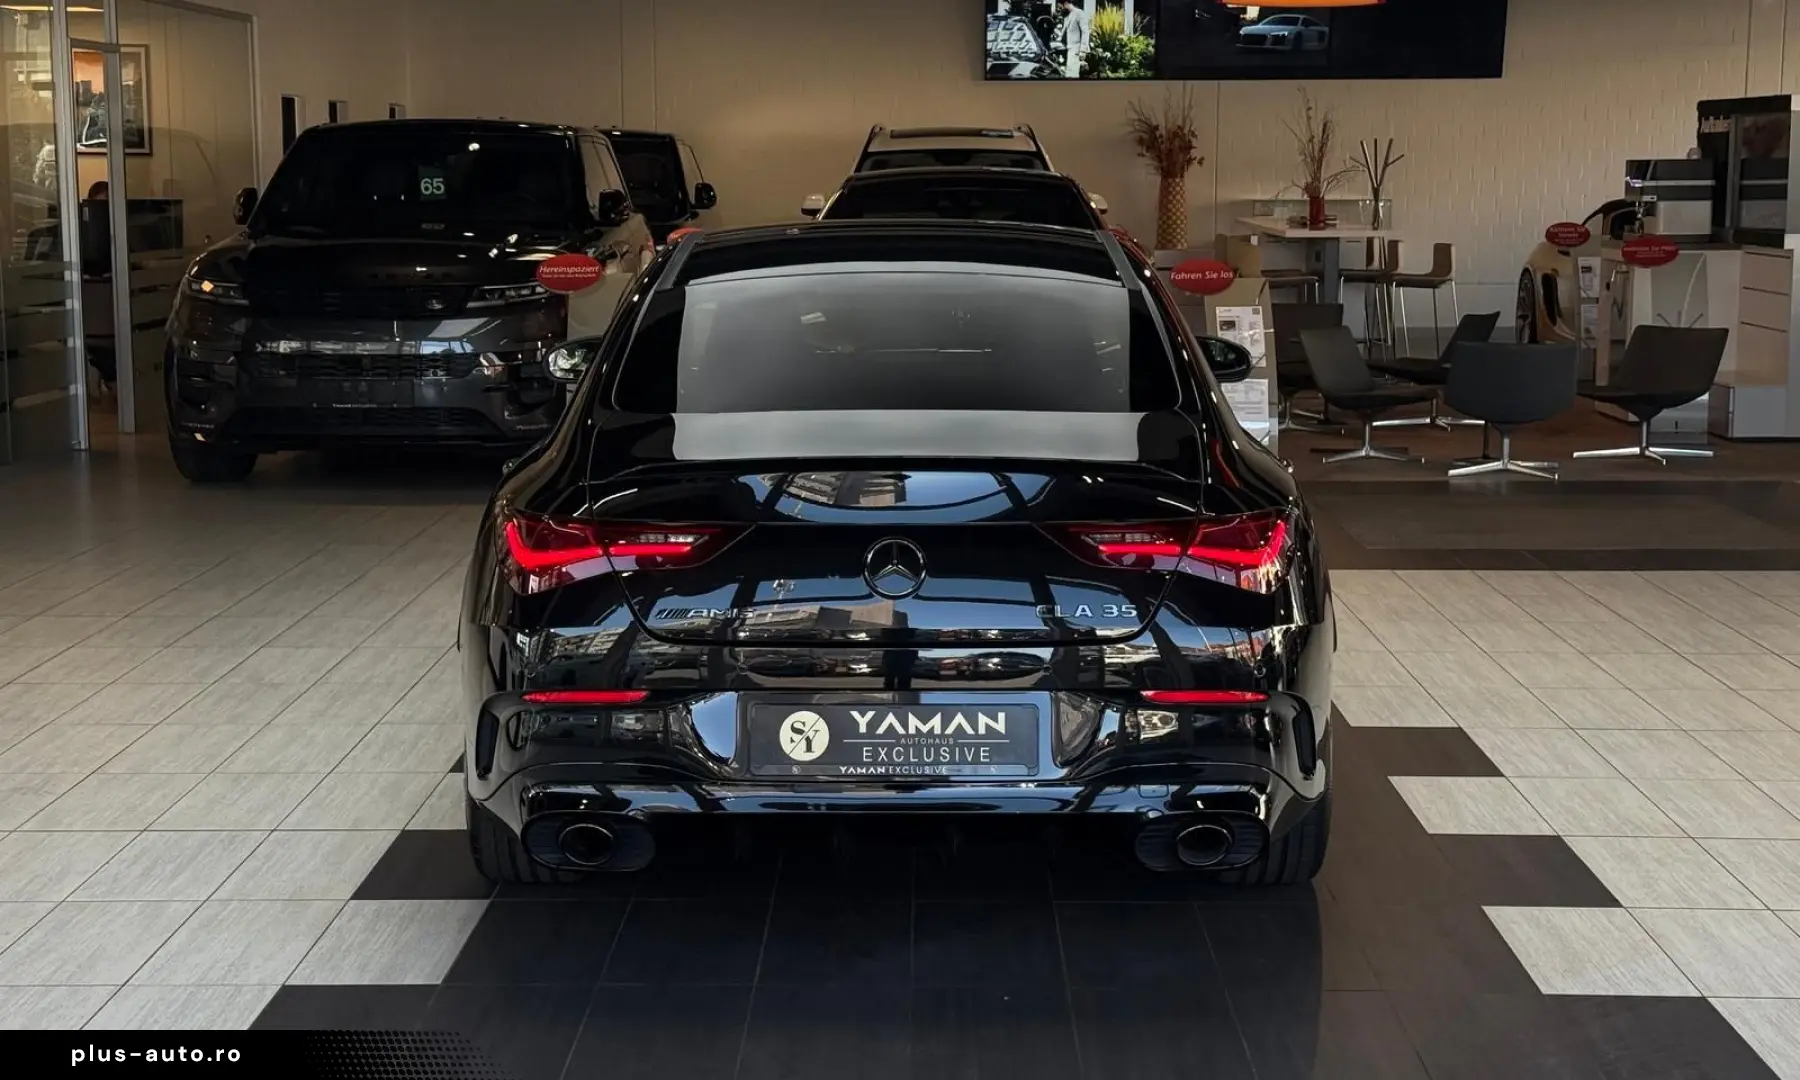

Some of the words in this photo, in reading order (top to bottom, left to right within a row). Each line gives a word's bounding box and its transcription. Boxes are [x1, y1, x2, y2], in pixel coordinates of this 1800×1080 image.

[420, 178, 445, 195] 65
[539, 265, 600, 274] Hereinspaziert
[1170, 271, 1202, 280] Fahren
[1204, 271, 1219, 279] Sie
[1220, 270, 1234, 279] los
[1036, 604, 1093, 618] CLA
[1102, 604, 1137, 618] 35
[850, 711, 1006, 735] YAMAN
[900, 737, 955, 745] AUTOHAUS
[862, 746, 991, 763] EXCLUSIVE
[839, 766, 885, 775] YAMAN
[888, 766, 948, 775] EXCLUSIVE
